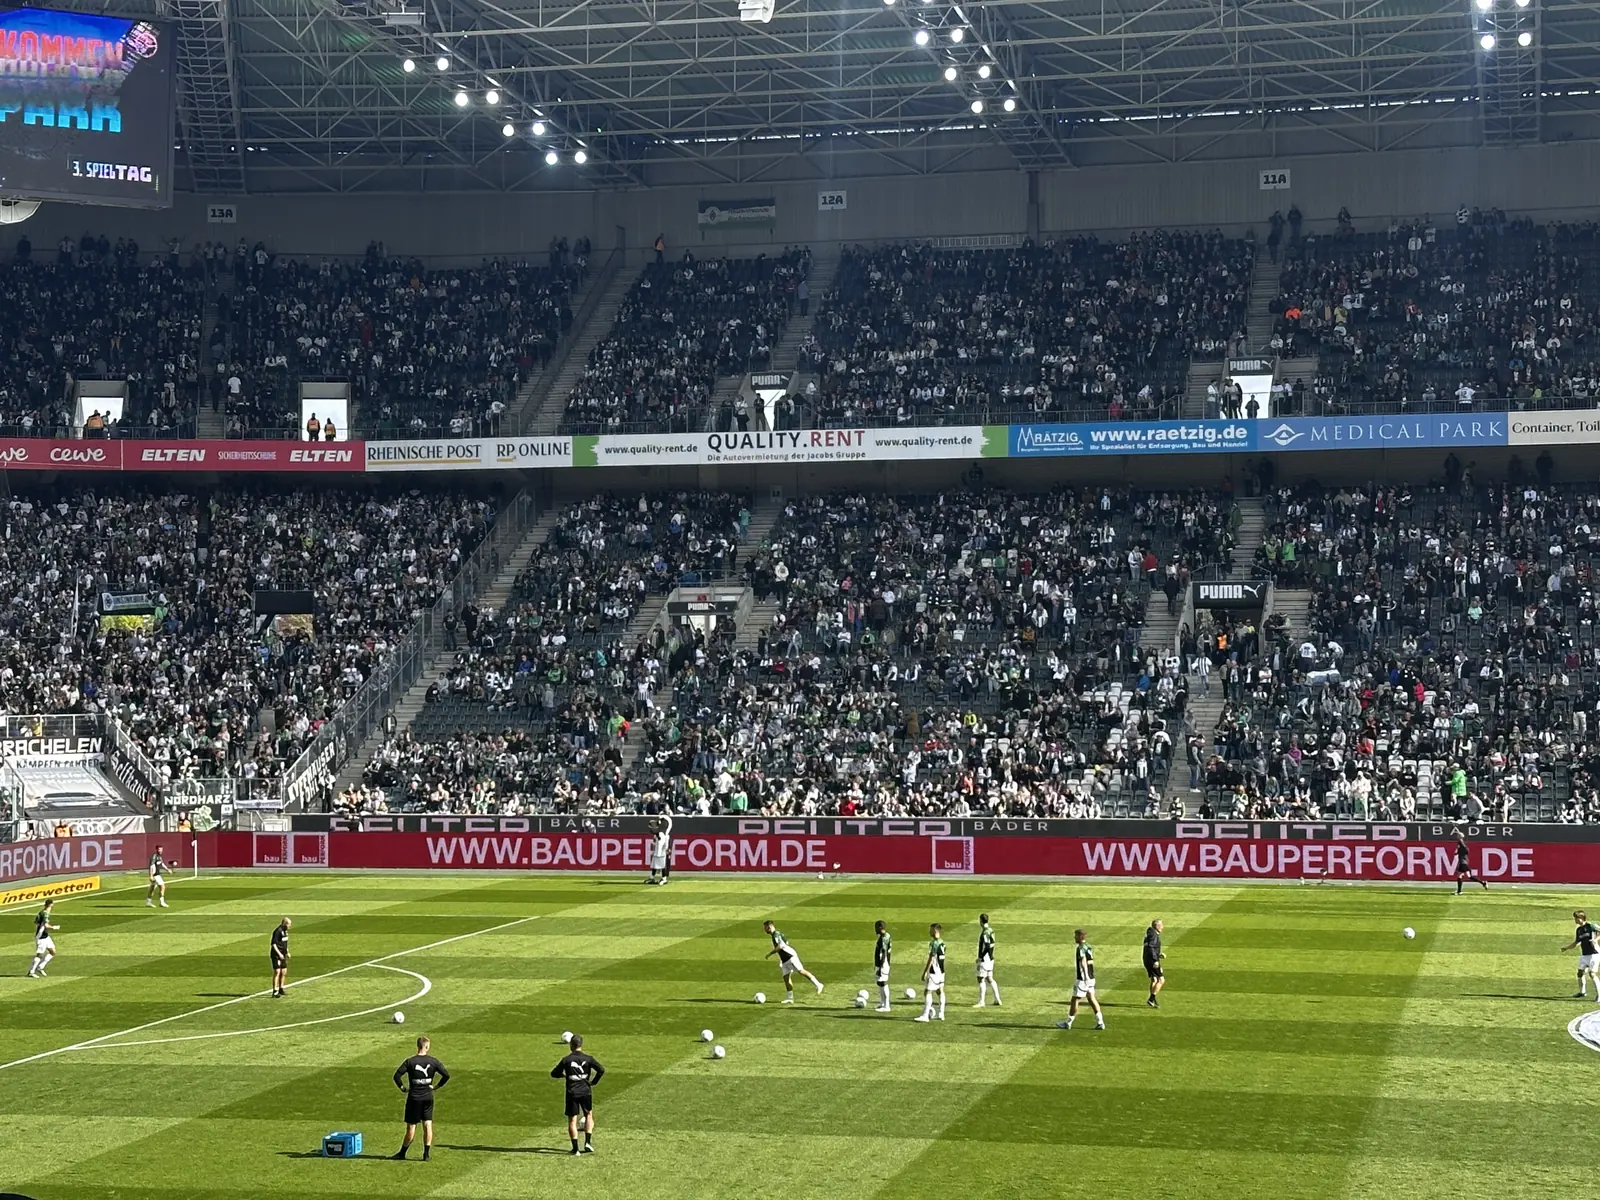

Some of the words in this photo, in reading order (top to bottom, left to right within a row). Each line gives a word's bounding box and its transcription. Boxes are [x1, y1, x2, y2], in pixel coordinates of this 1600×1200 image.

[72, 161, 83, 177] 3.
[1263, 174, 1287, 184] 11A
[821, 195, 844, 206] 12A
[210, 208, 234, 219] 13A
[1230, 360, 1260, 371] PUMA
[752, 375, 780, 385] PUMA
[1090, 424, 1248, 442] www.raetzig.de
[1310, 422, 1425, 442] MEDICAL
[1439, 420, 1503, 438] PARK
[1512, 421, 1574, 434] Container,
[707, 429, 866, 453] QUALITY.RENT
[874, 434, 973, 448] www.quality-rent.de
[0, 447, 28, 461] we
[50, 447, 106, 462] cewe
[141, 448, 206, 462] ELTEN
[367, 444, 444, 461] RHEINISCHE
[446, 444, 482, 459] POST
[496, 443, 515, 457] RP
[518, 441, 571, 457] ONLINE
[604, 441, 699, 456] www.quality-rent.de
[289, 449, 352, 463] ELTEN
[707, 454, 721, 462] Die
[791, 451, 805, 460] der
[836, 450, 866, 460] Gruppe
[1200, 585, 1242, 599] PUMA
[0, 737, 102, 757] RACHELEN
[974, 820, 1049, 832] BÄDER
[264, 855, 280, 863] bau
[302, 855, 318, 863] bau
[944, 860, 962, 869] bau
[1082, 842, 1535, 878] WWW.BAUPERFORM.DE
[3, 882, 93, 904] interwetten
